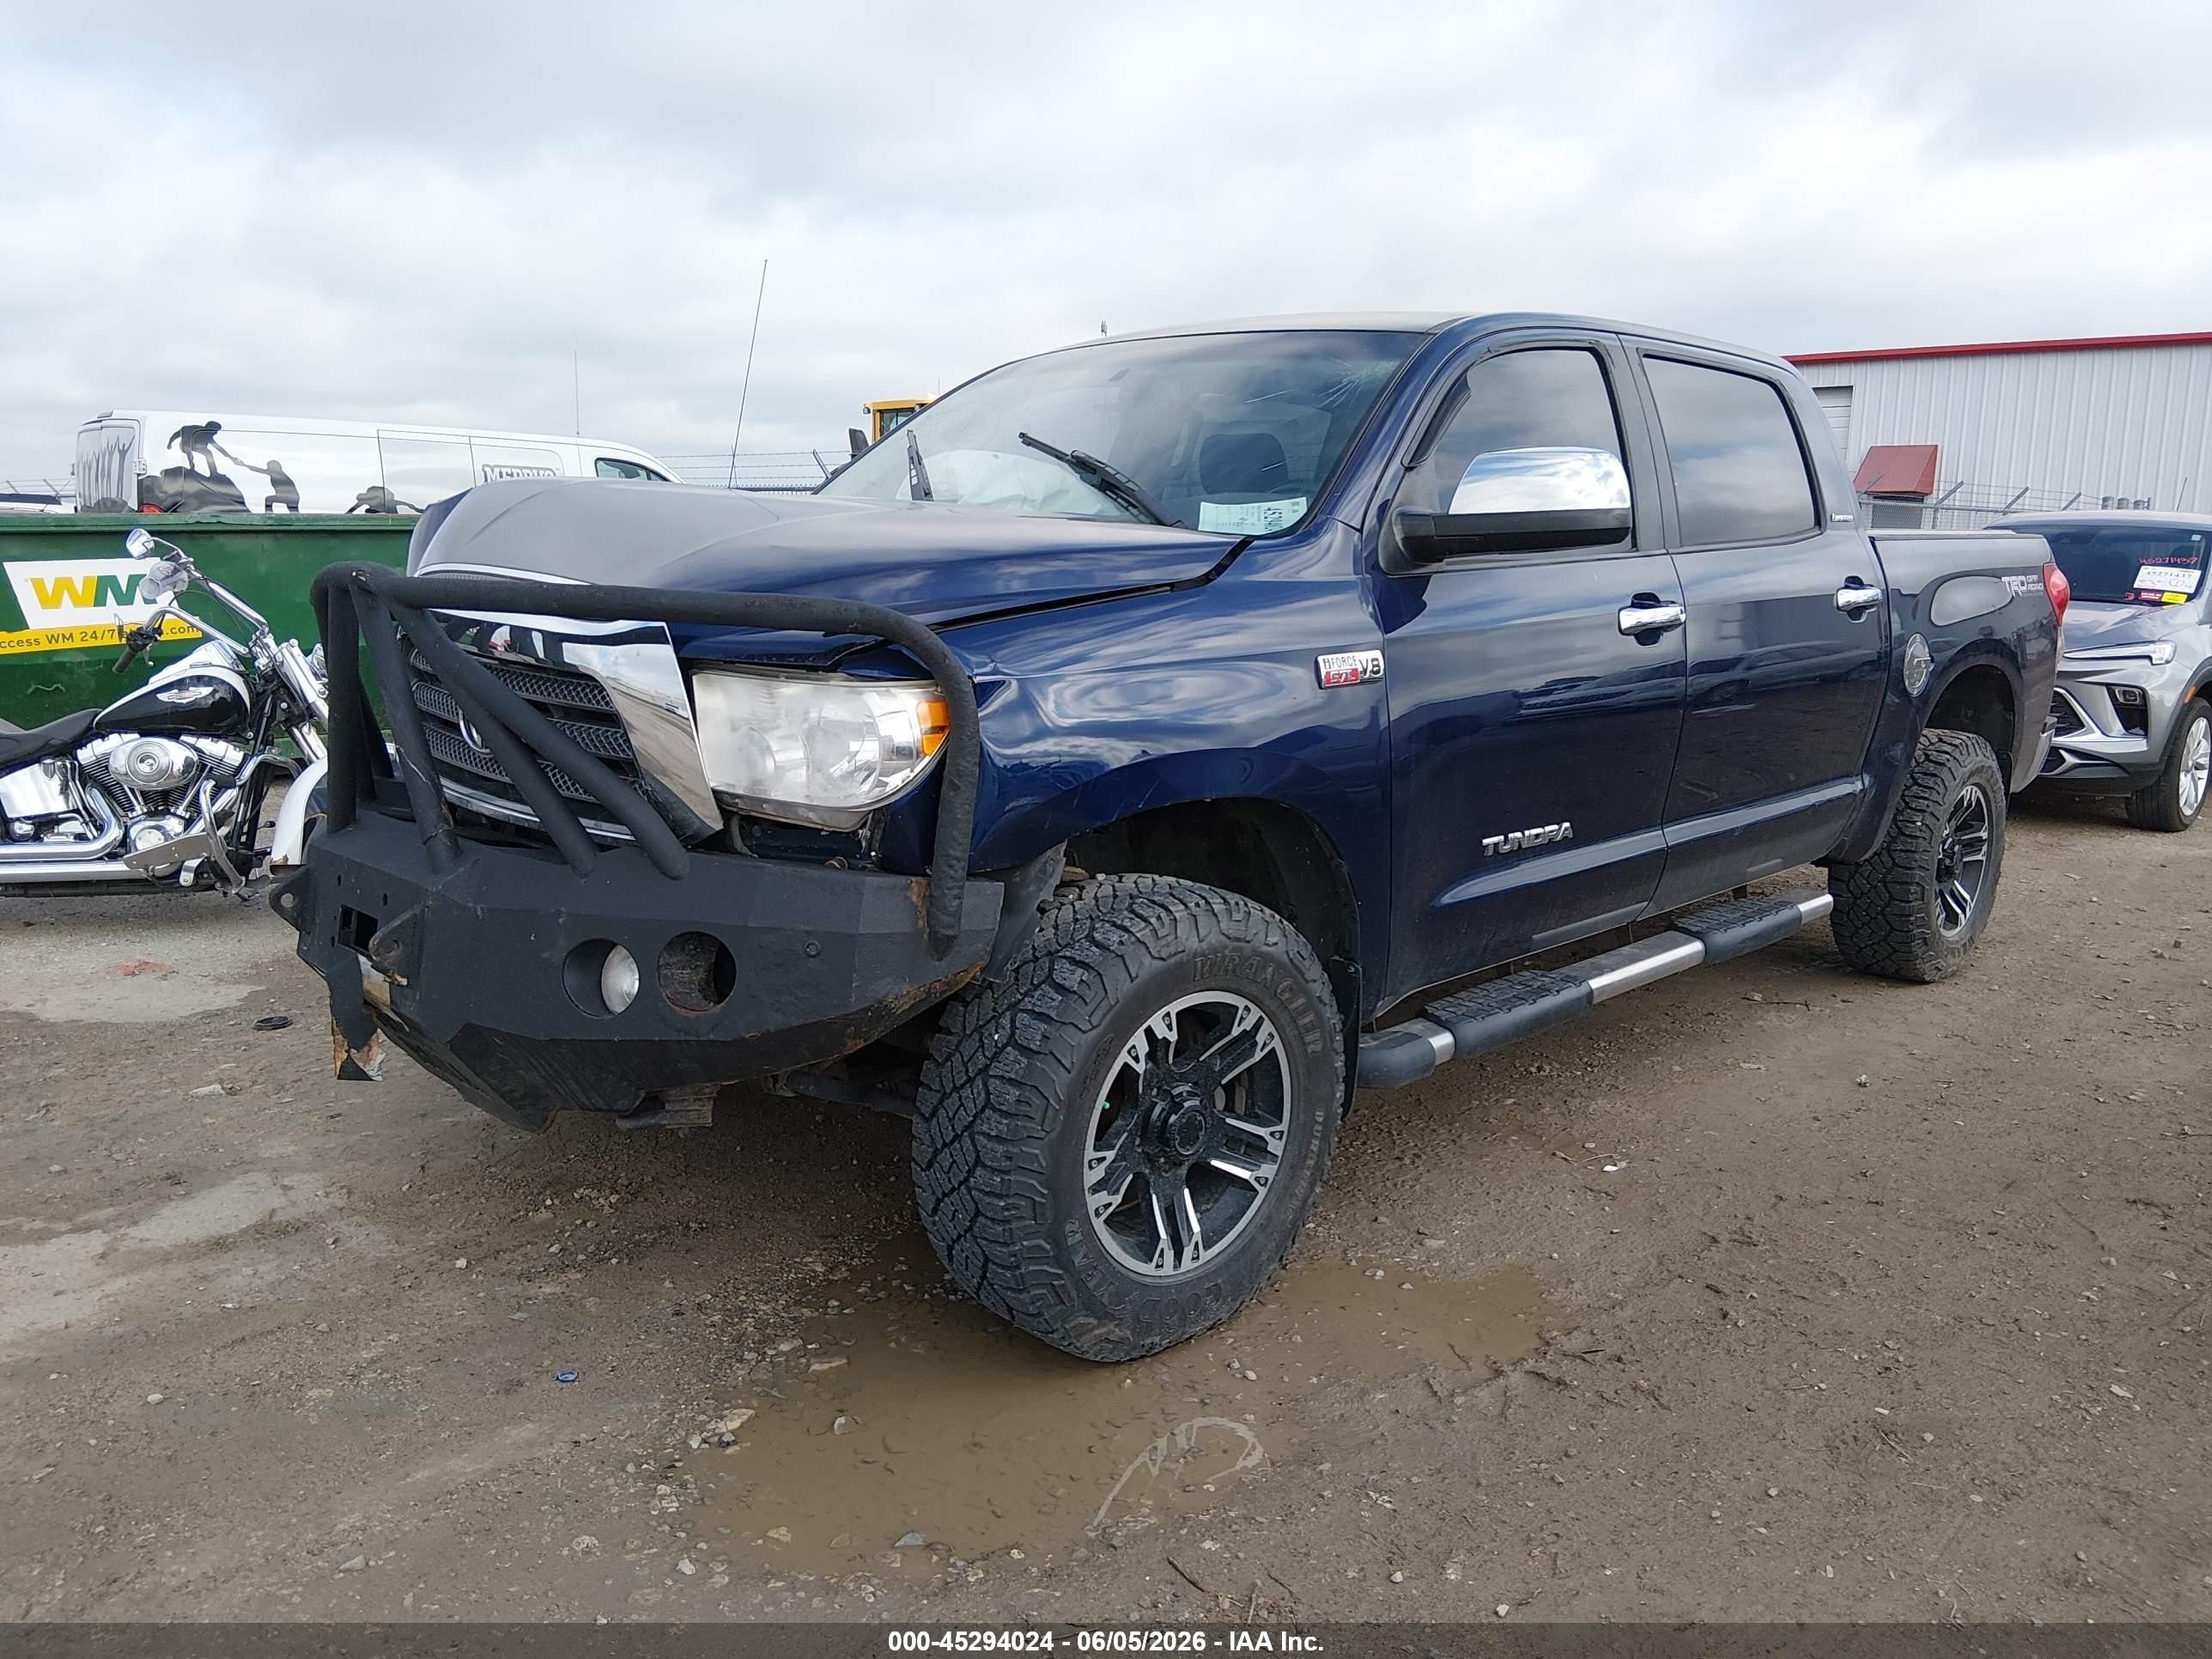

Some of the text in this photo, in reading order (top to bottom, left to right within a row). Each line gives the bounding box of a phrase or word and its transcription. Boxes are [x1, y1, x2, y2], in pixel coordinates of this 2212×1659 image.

[30, 573, 158, 610] WM
[2002, 575, 2027, 598] TRD
[0, 638, 41, 648] ccess
[46, 632, 75, 645] WM
[80, 629, 115, 642] 24/7
[1358, 657, 1382, 677] V8
[1481, 822, 1573, 856] TUNDRA
[1193, 952, 1323, 1055] WRANGLER
